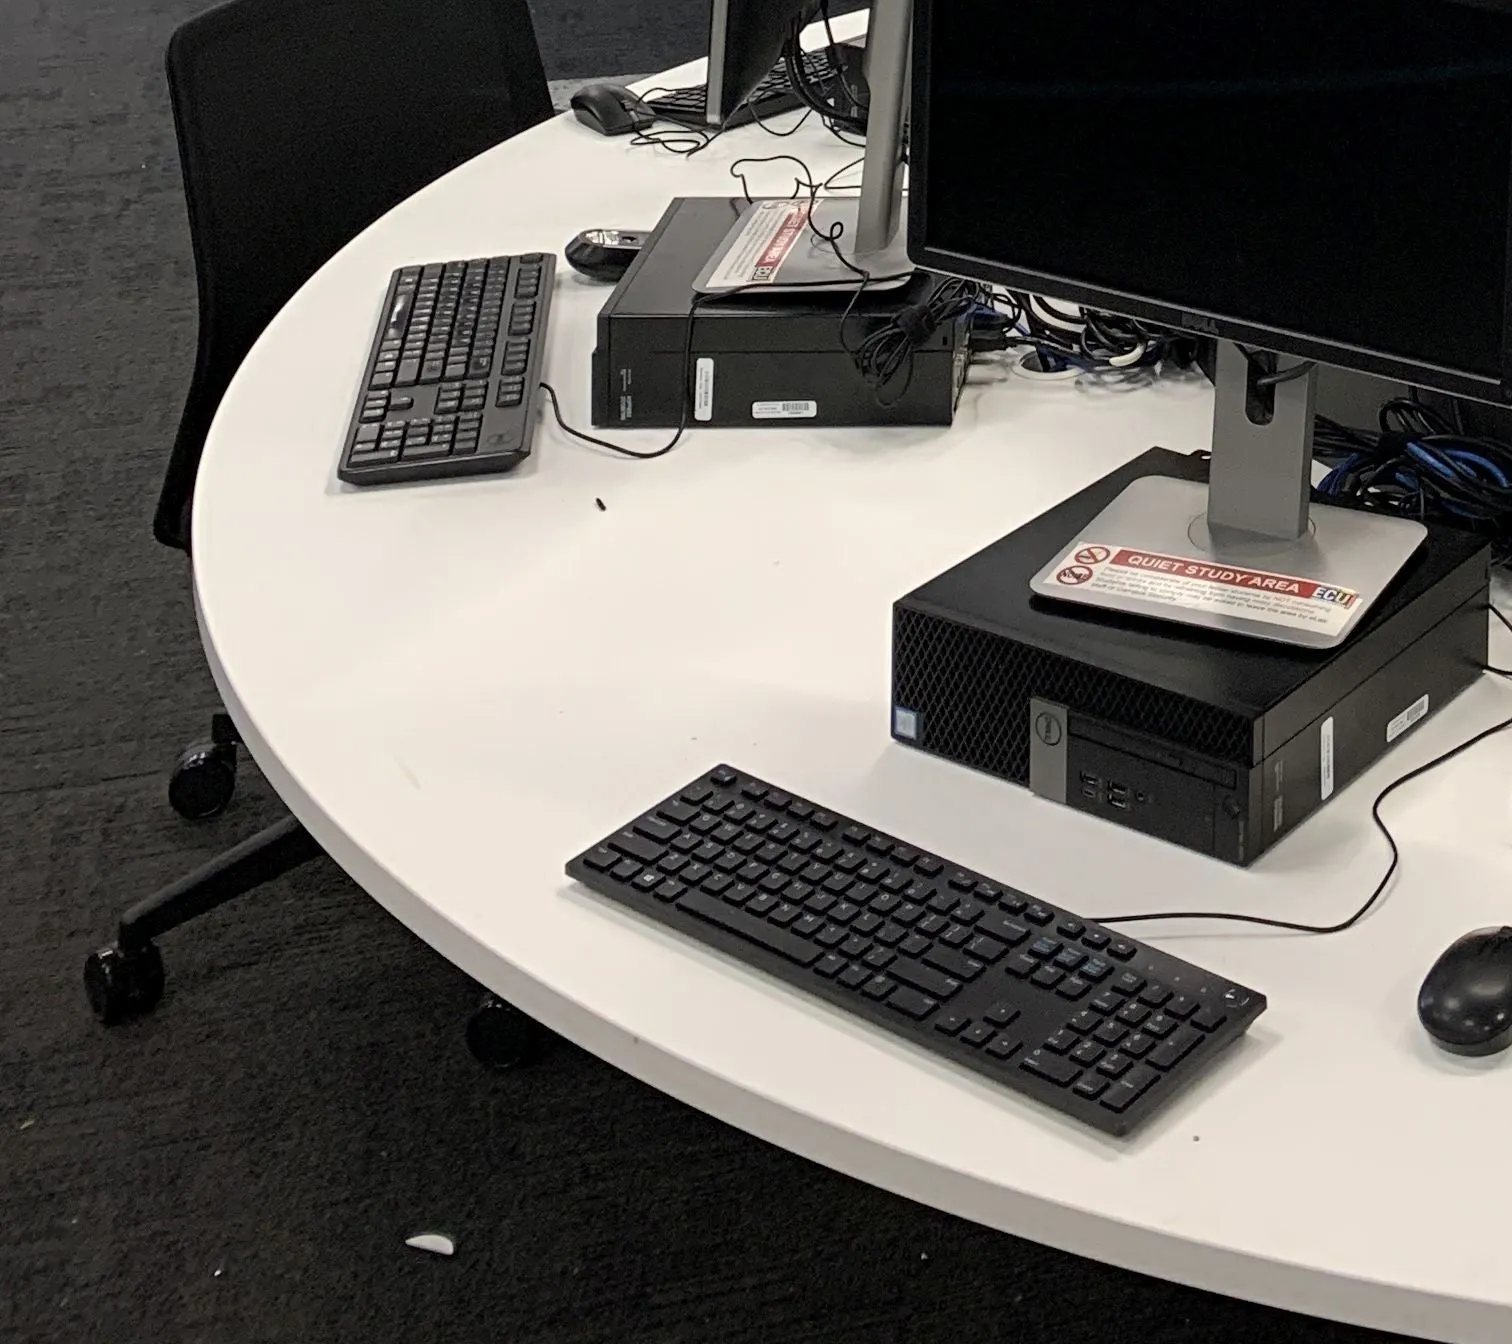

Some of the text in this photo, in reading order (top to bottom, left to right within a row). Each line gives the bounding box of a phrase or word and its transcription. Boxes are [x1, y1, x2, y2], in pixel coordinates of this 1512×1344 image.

[1128, 555, 1301, 593] QUIET STUDY AREA
[1312, 587, 1350, 606] ECU
